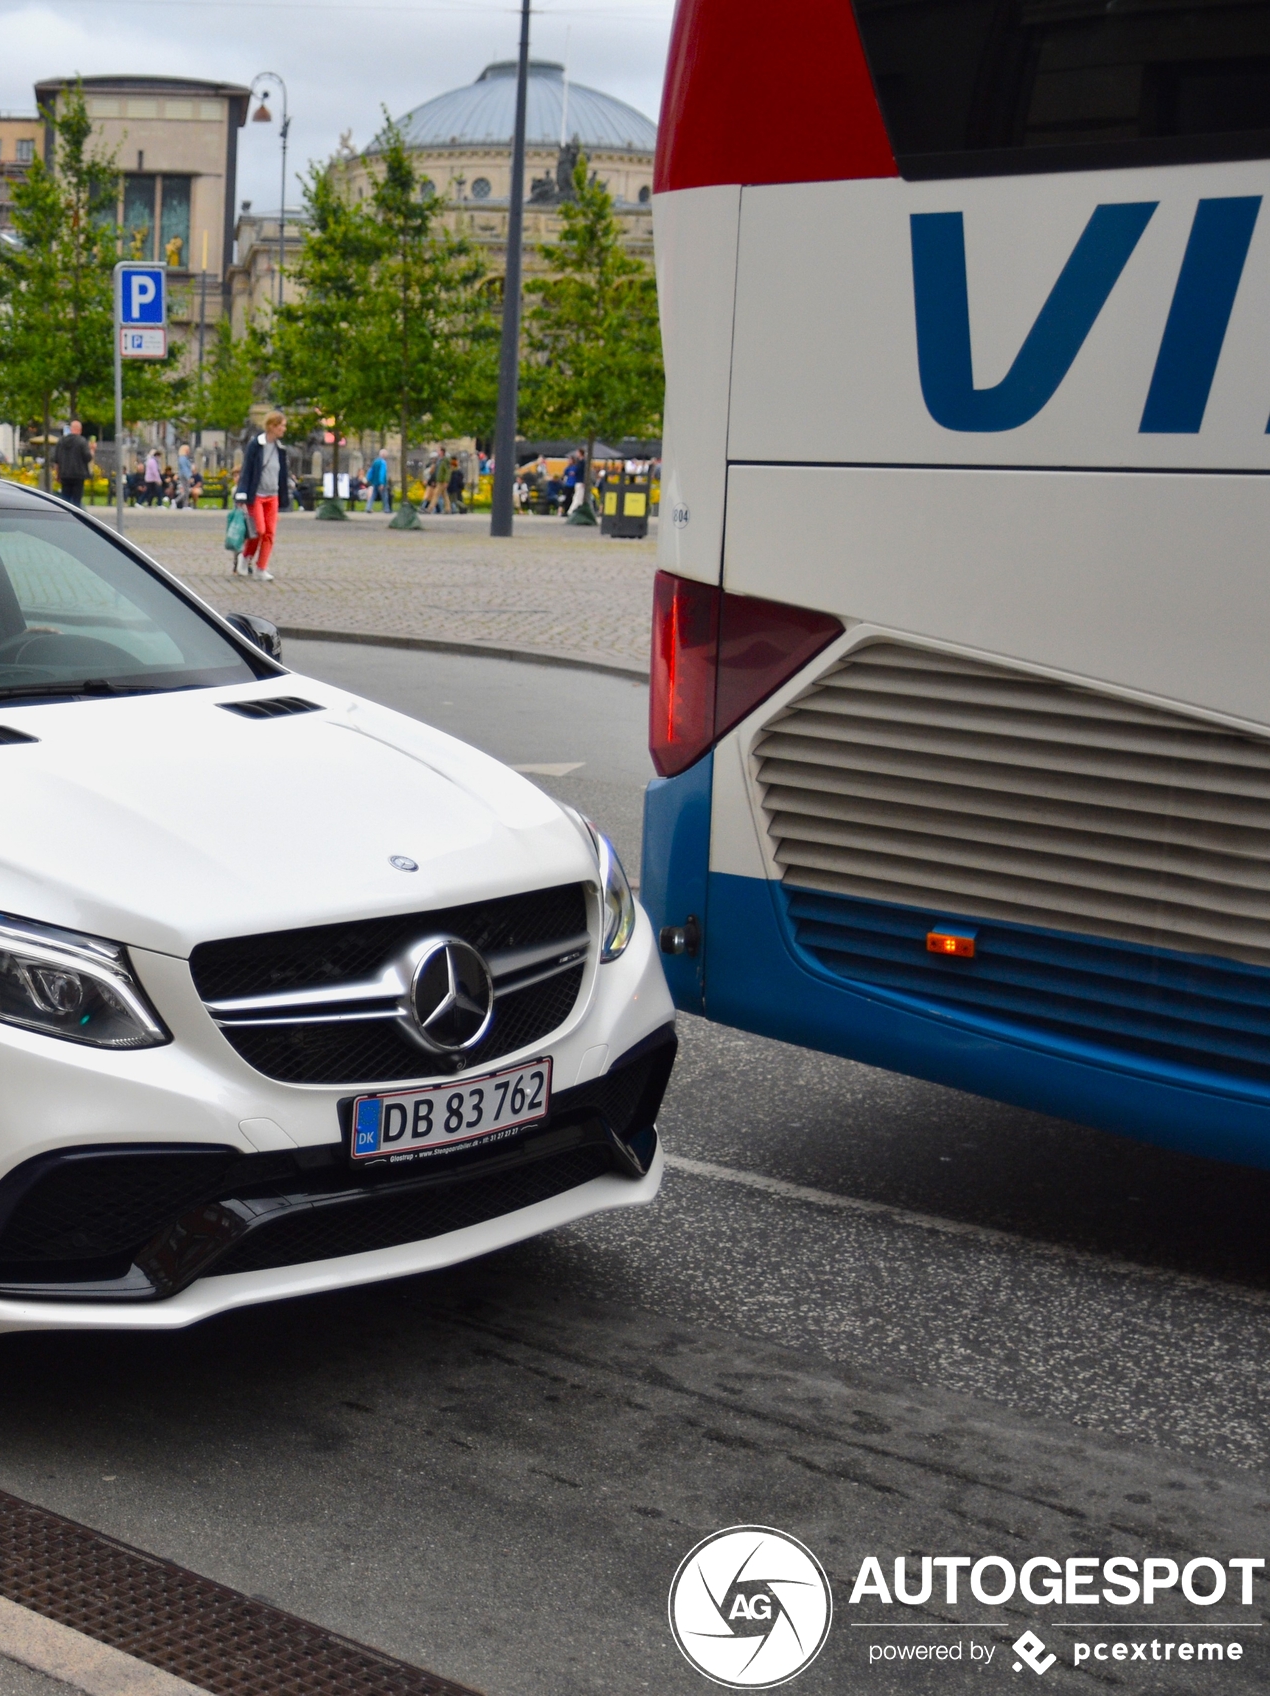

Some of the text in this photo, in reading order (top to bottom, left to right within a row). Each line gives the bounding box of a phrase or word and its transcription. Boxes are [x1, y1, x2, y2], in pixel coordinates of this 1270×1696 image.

[131, 275, 156, 319] P
[910, 195, 1270, 434] VI
[673, 509, 688, 522] 804
[383, 1070, 544, 1143] DB 83 762
[358, 1131, 374, 1145] DK
